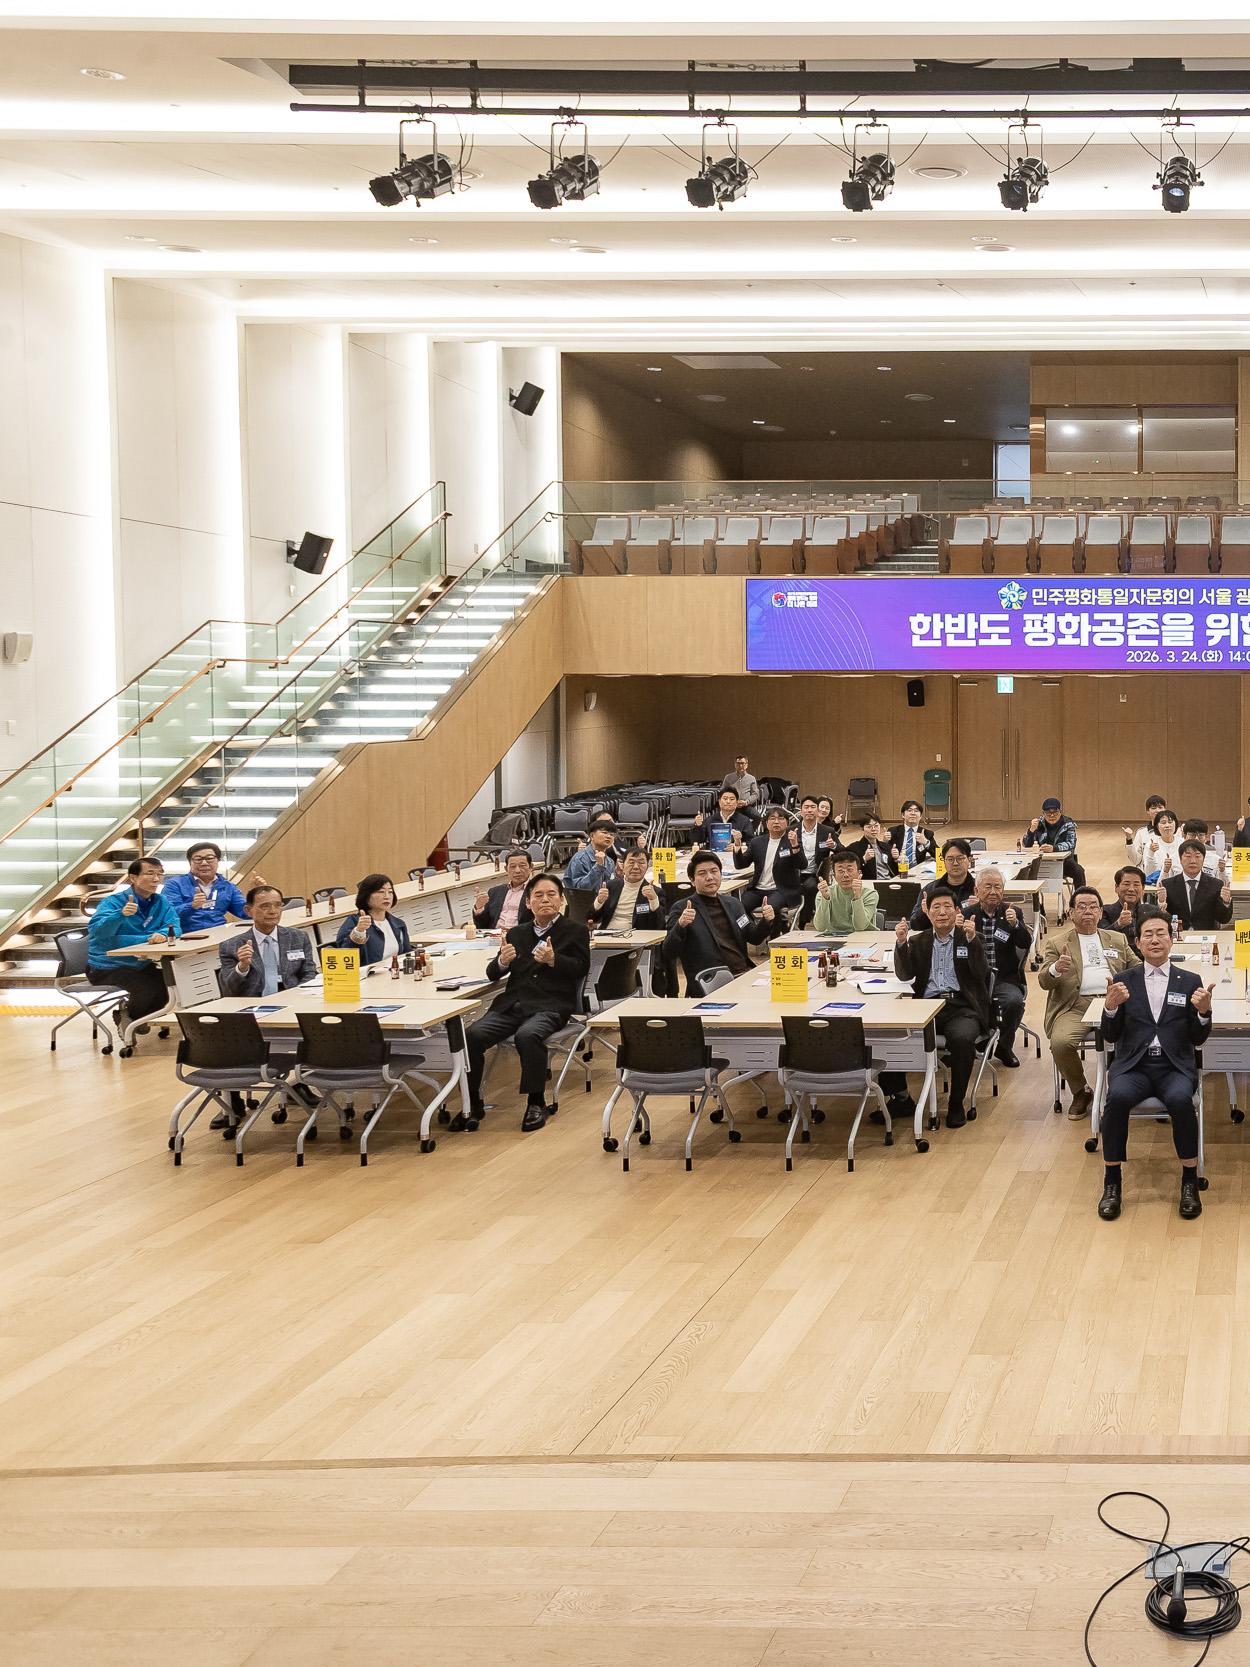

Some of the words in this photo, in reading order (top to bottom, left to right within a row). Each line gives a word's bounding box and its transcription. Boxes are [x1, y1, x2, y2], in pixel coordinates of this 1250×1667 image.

[1031, 588, 1194, 606] 민주평화통일자문회의
[1198, 588, 1232, 606] 서울
[909, 612, 1012, 647] 한반도
[1022, 612, 1195, 647] 평화공존을
[1126, 650, 1163, 663] 2026.
[1166, 650, 1178, 663] 3.
[1181, 650, 1223, 663] 24.(화)
[326, 956, 354, 970] 통일
[774, 956, 804, 969] 평화
